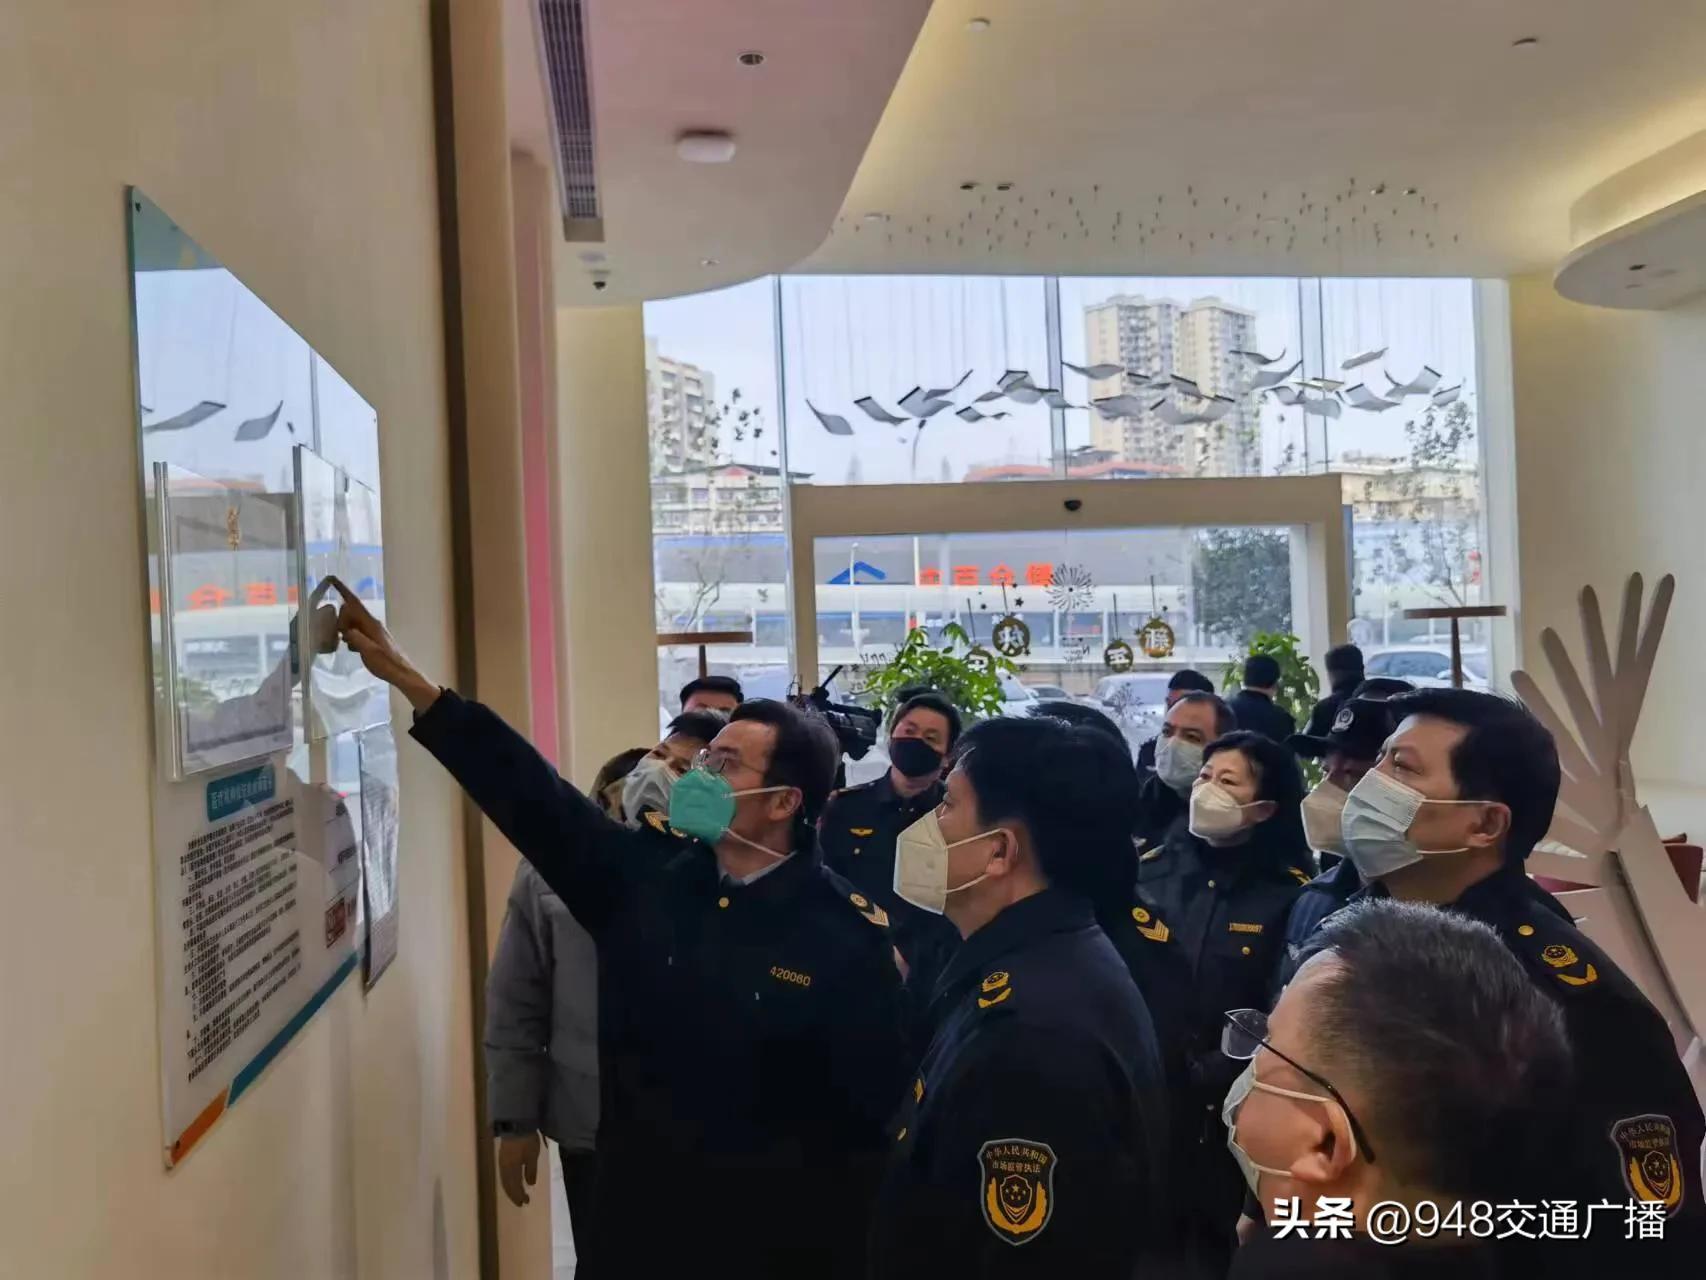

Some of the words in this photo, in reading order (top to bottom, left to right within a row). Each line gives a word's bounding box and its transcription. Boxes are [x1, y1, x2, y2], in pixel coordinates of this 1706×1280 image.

[986, 1145, 1048, 1164] 中华人民共和国
[992, 1161, 1041, 1173] 市场监管执法
